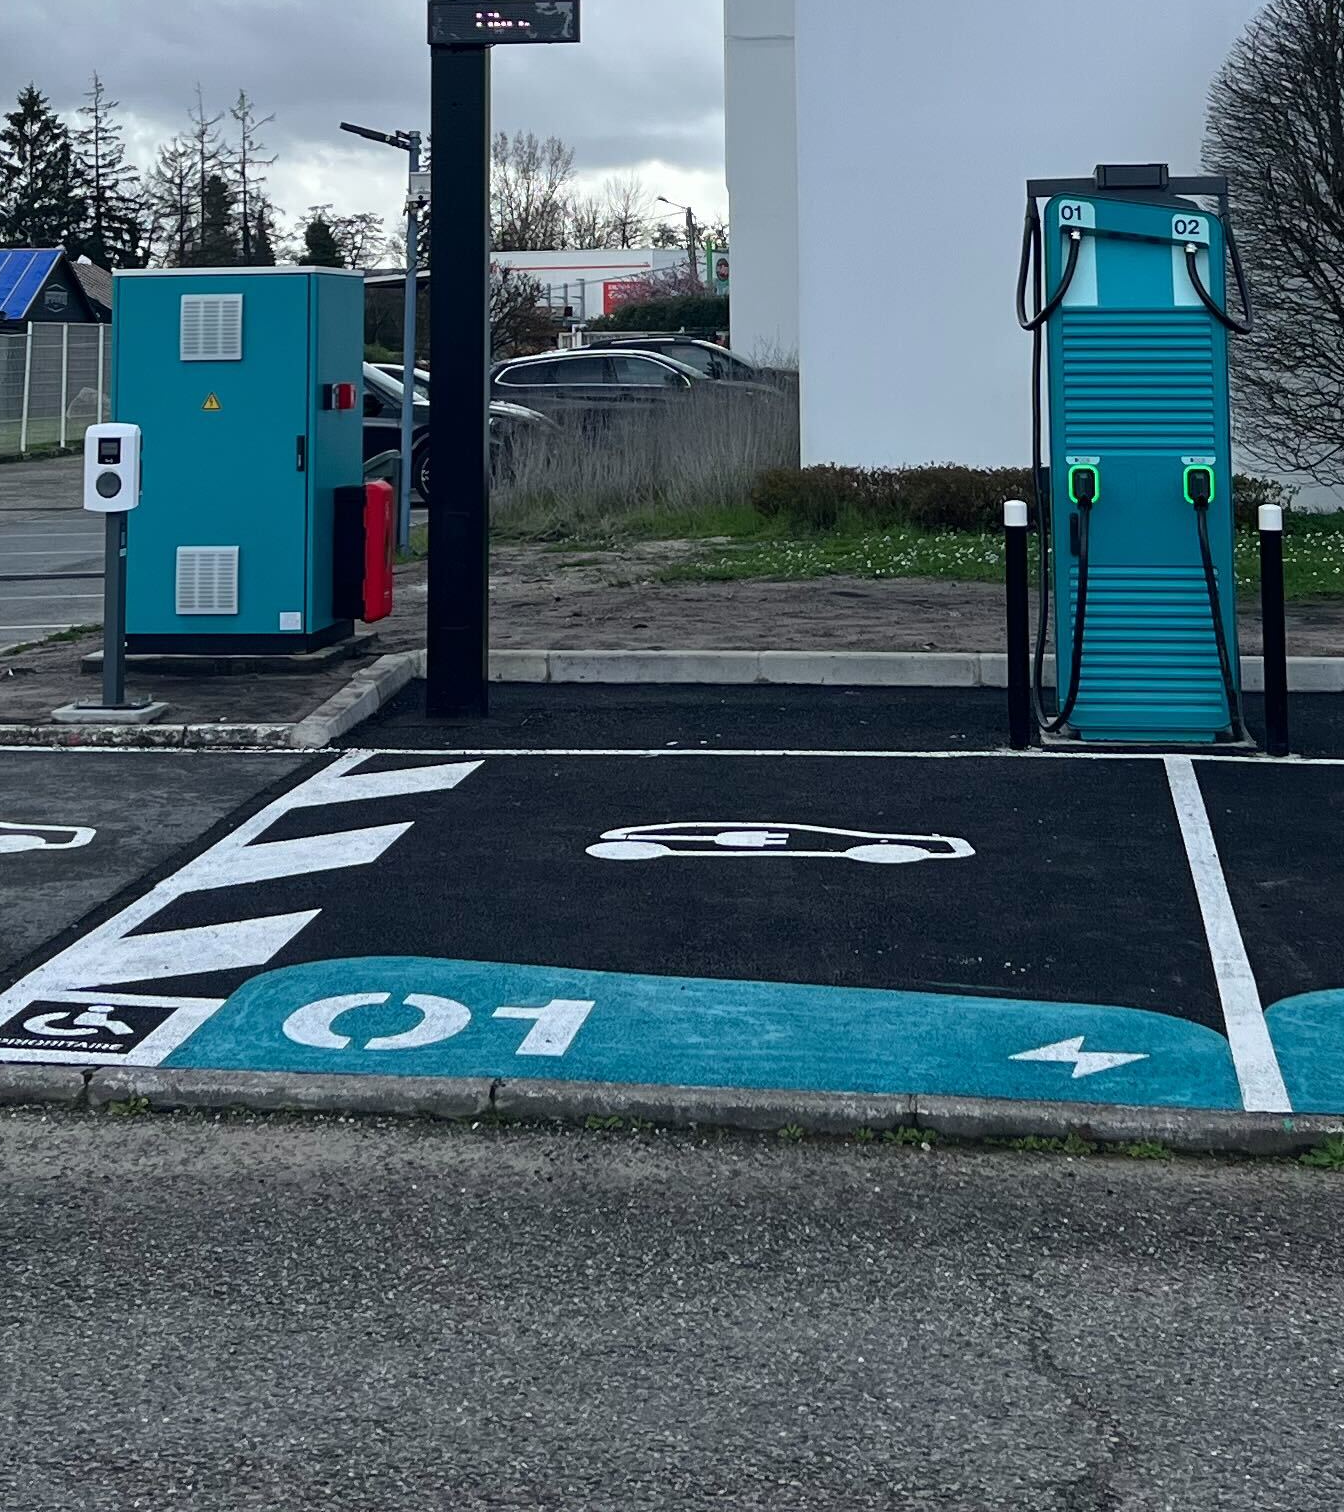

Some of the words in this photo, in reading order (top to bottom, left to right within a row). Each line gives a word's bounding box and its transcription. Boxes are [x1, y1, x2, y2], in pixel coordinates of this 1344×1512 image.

[1061, 205, 1082, 221] 01
[1174, 219, 1200, 235] 02
[282, 991, 596, 1057] 01
